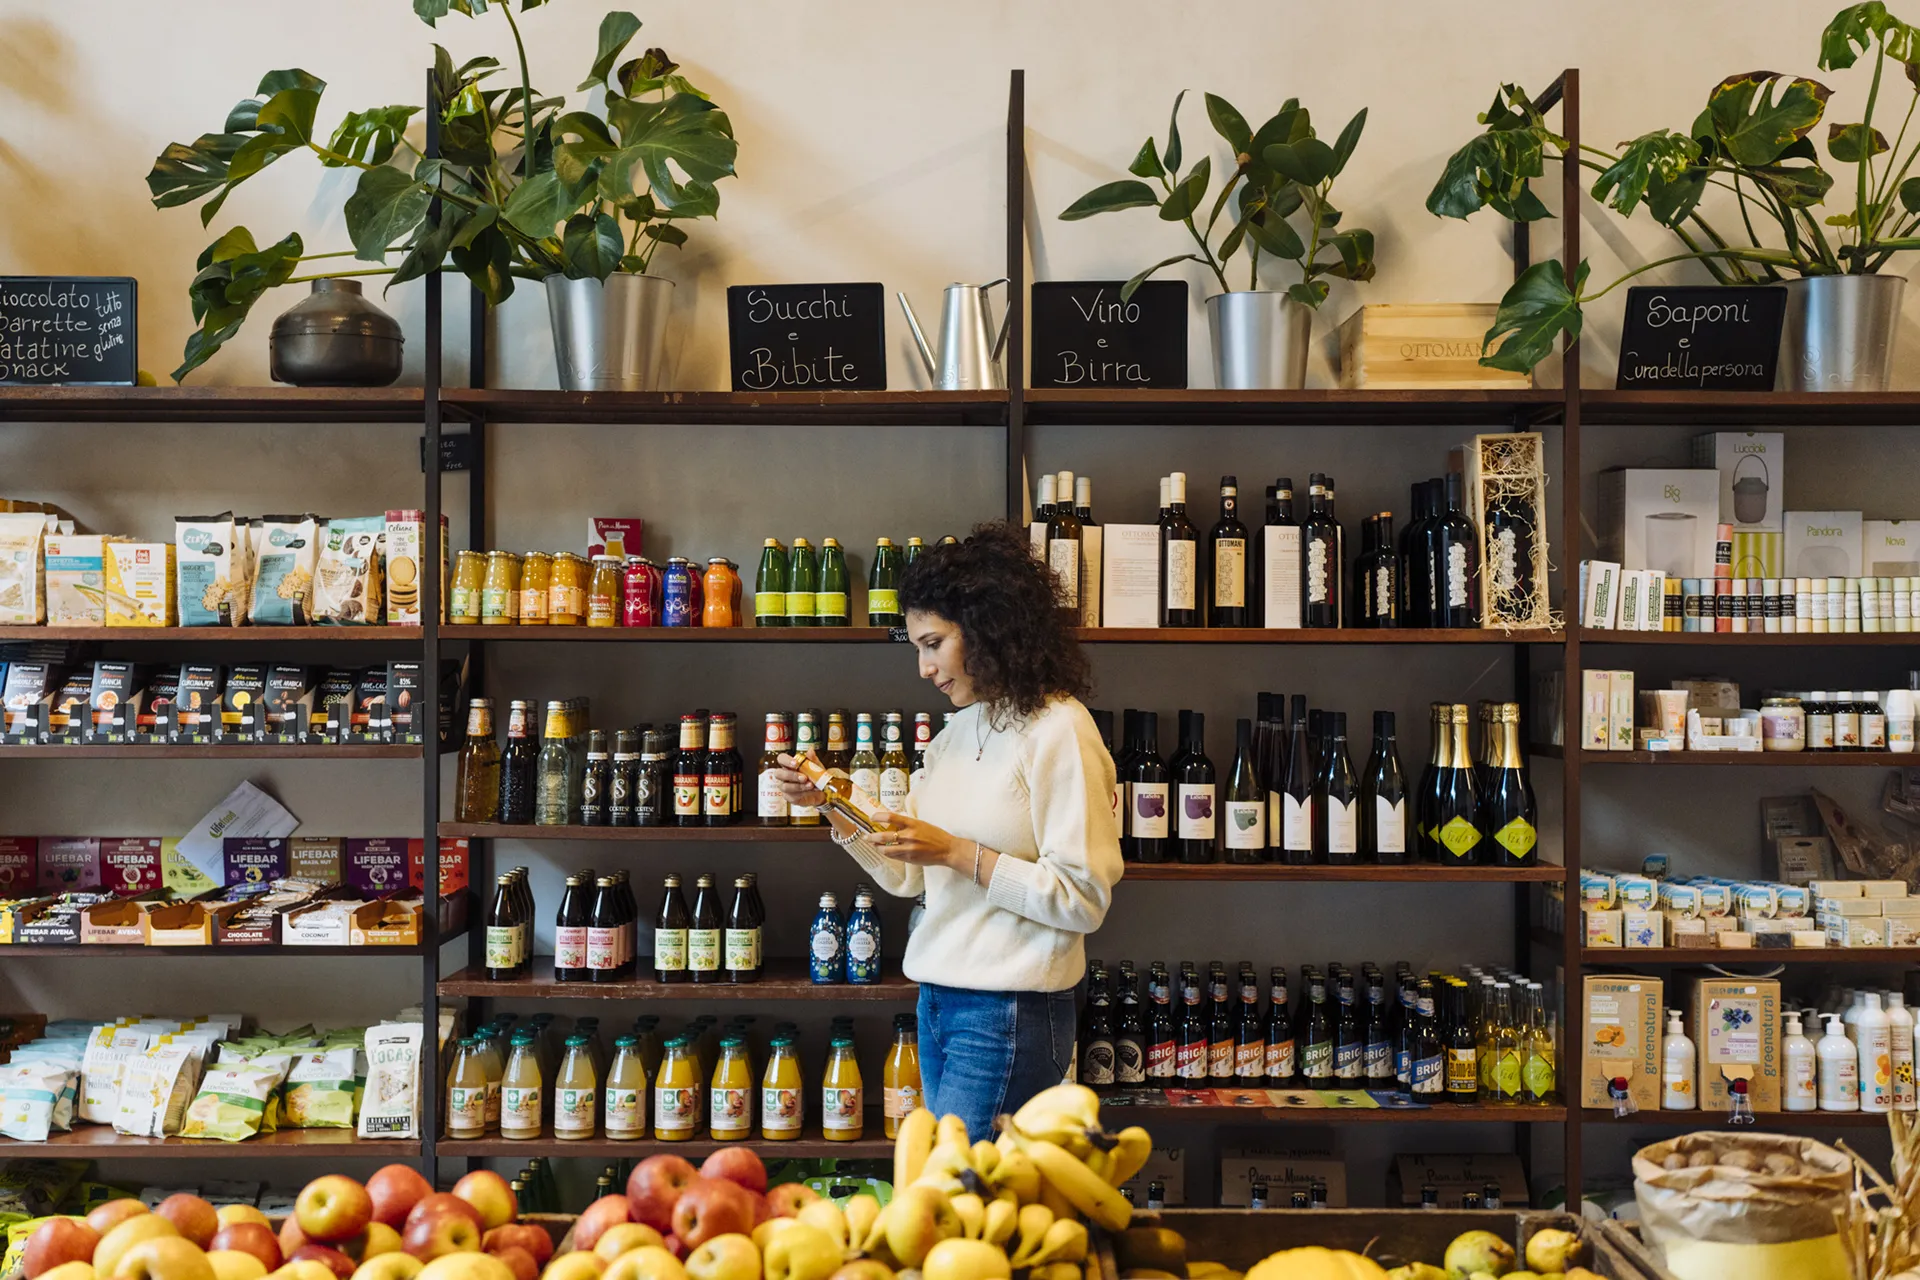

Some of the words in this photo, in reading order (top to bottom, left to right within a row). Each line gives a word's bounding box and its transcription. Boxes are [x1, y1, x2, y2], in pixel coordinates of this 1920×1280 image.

[95, 291, 122, 317] tutto
[747, 289, 852, 323] Succhi
[1071, 289, 1140, 323] Vino
[1647, 296, 1750, 334] Saponi
[788, 332, 799, 340] e
[0, 333, 90, 359] atatine
[1097, 338, 1108, 348] e
[1678, 338, 1691, 348] e
[742, 347, 858, 389] Bibite
[1054, 351, 1151, 383] Birra
[1701, 363, 1764, 387] persona
[1664, 485, 1681, 502] Big
[1807, 525, 1843, 537] Pandora
[1886, 535, 1905, 546] Nova
[45, 854, 92, 863] LIFEBAR
[107, 855, 155, 864] LIFEBAR
[230, 854, 278, 863] LIFEBAR
[292, 850, 339, 859] LIFEBAR
[354, 855, 401, 865] LIFEBAR
